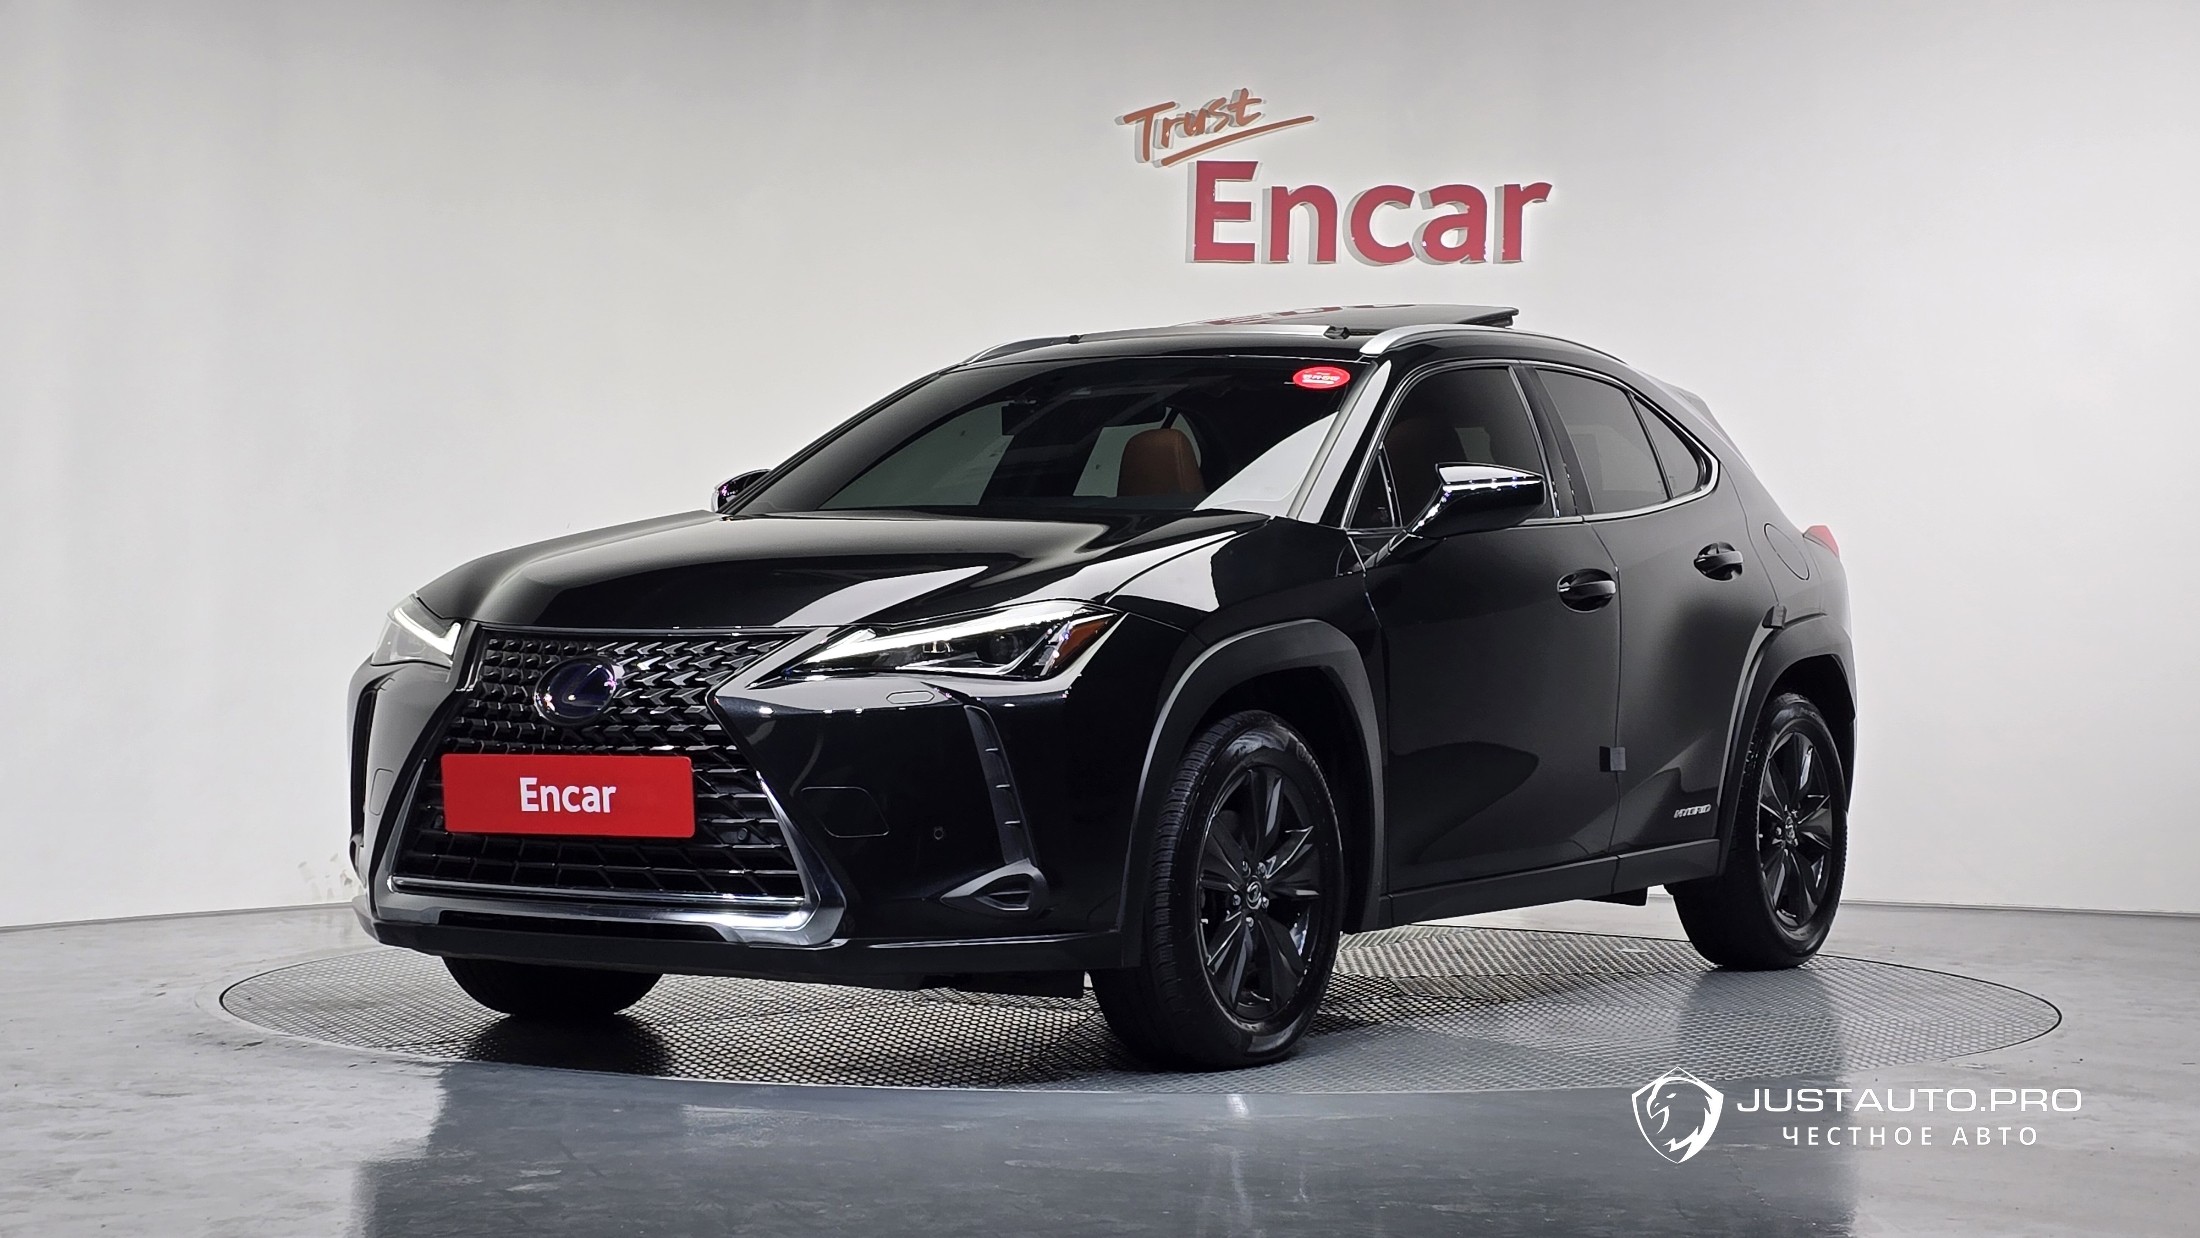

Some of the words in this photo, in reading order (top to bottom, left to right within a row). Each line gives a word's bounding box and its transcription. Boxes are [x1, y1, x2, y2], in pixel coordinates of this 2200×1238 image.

[1118, 87, 1262, 162] Trust
[1188, 160, 1553, 264] Encar
[519, 777, 617, 814] Encar
[1673, 803, 1712, 819] HYBRID
